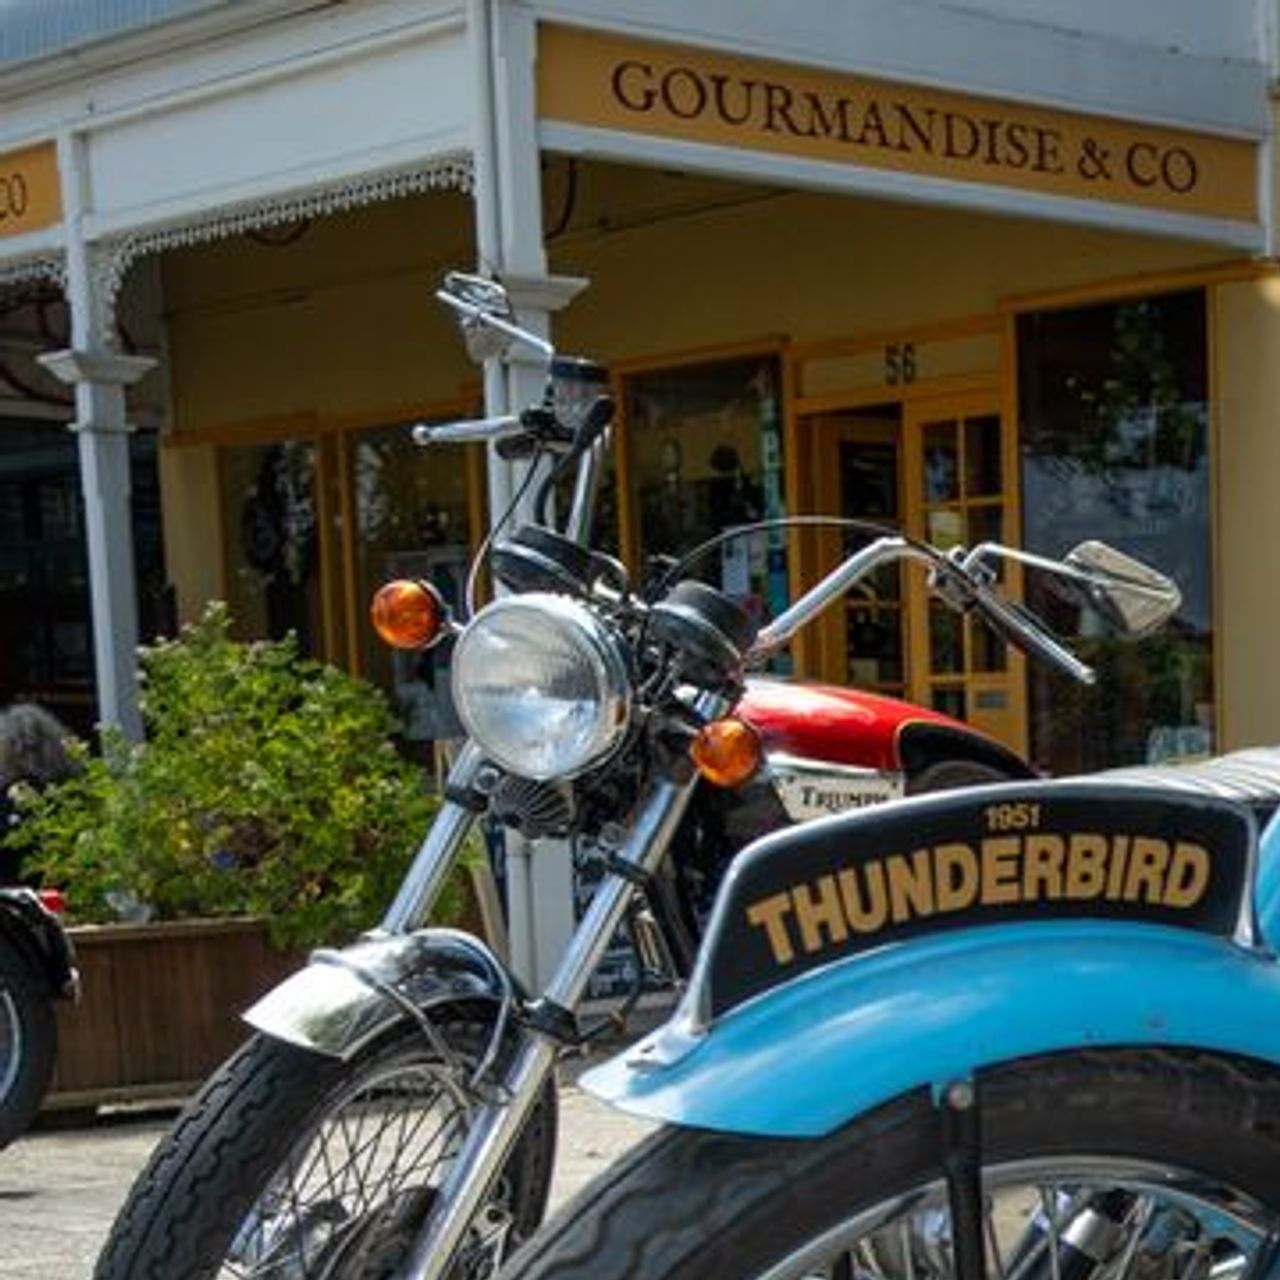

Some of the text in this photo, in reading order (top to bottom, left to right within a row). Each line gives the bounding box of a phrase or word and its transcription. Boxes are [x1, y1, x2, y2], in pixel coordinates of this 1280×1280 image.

[610, 60, 1199, 194] GOURMANDISE & CO
[885, 343, 916, 387] 56
[984, 803, 1040, 831] 1951
[746, 834, 1211, 965] THUNDERBIRD
